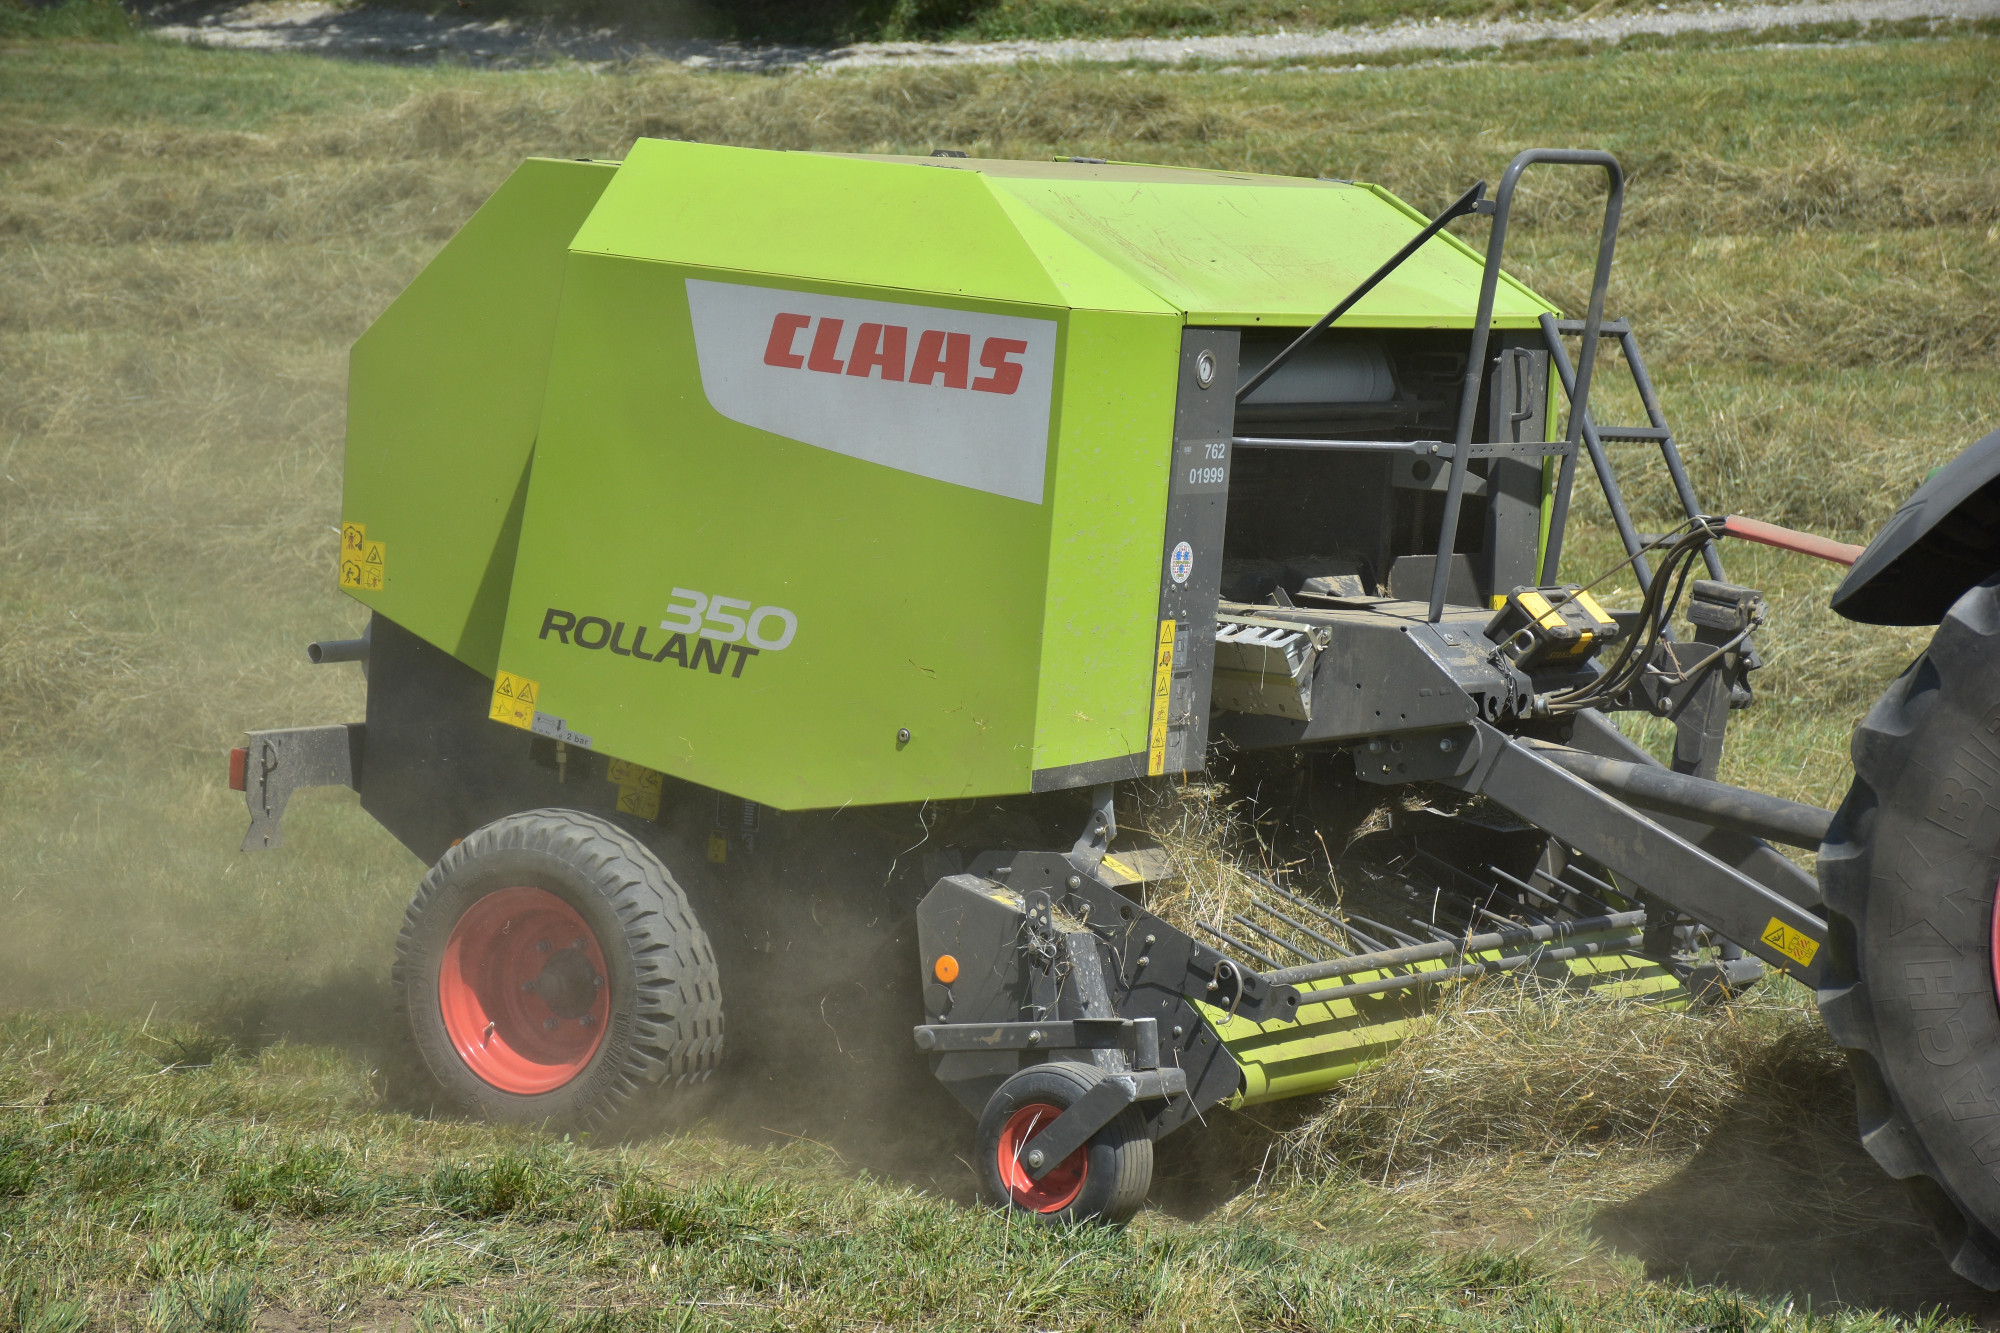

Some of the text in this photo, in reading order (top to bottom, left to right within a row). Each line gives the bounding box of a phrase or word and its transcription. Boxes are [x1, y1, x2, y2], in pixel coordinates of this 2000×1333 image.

[763, 312, 1028, 395] CLAAS
[1204, 442, 1226, 460] 762
[1189, 466, 1225, 485] 01999
[659, 586, 798, 651] 350
[538, 607, 760, 679] ROLLANT
[574, 735, 589, 745] bar
